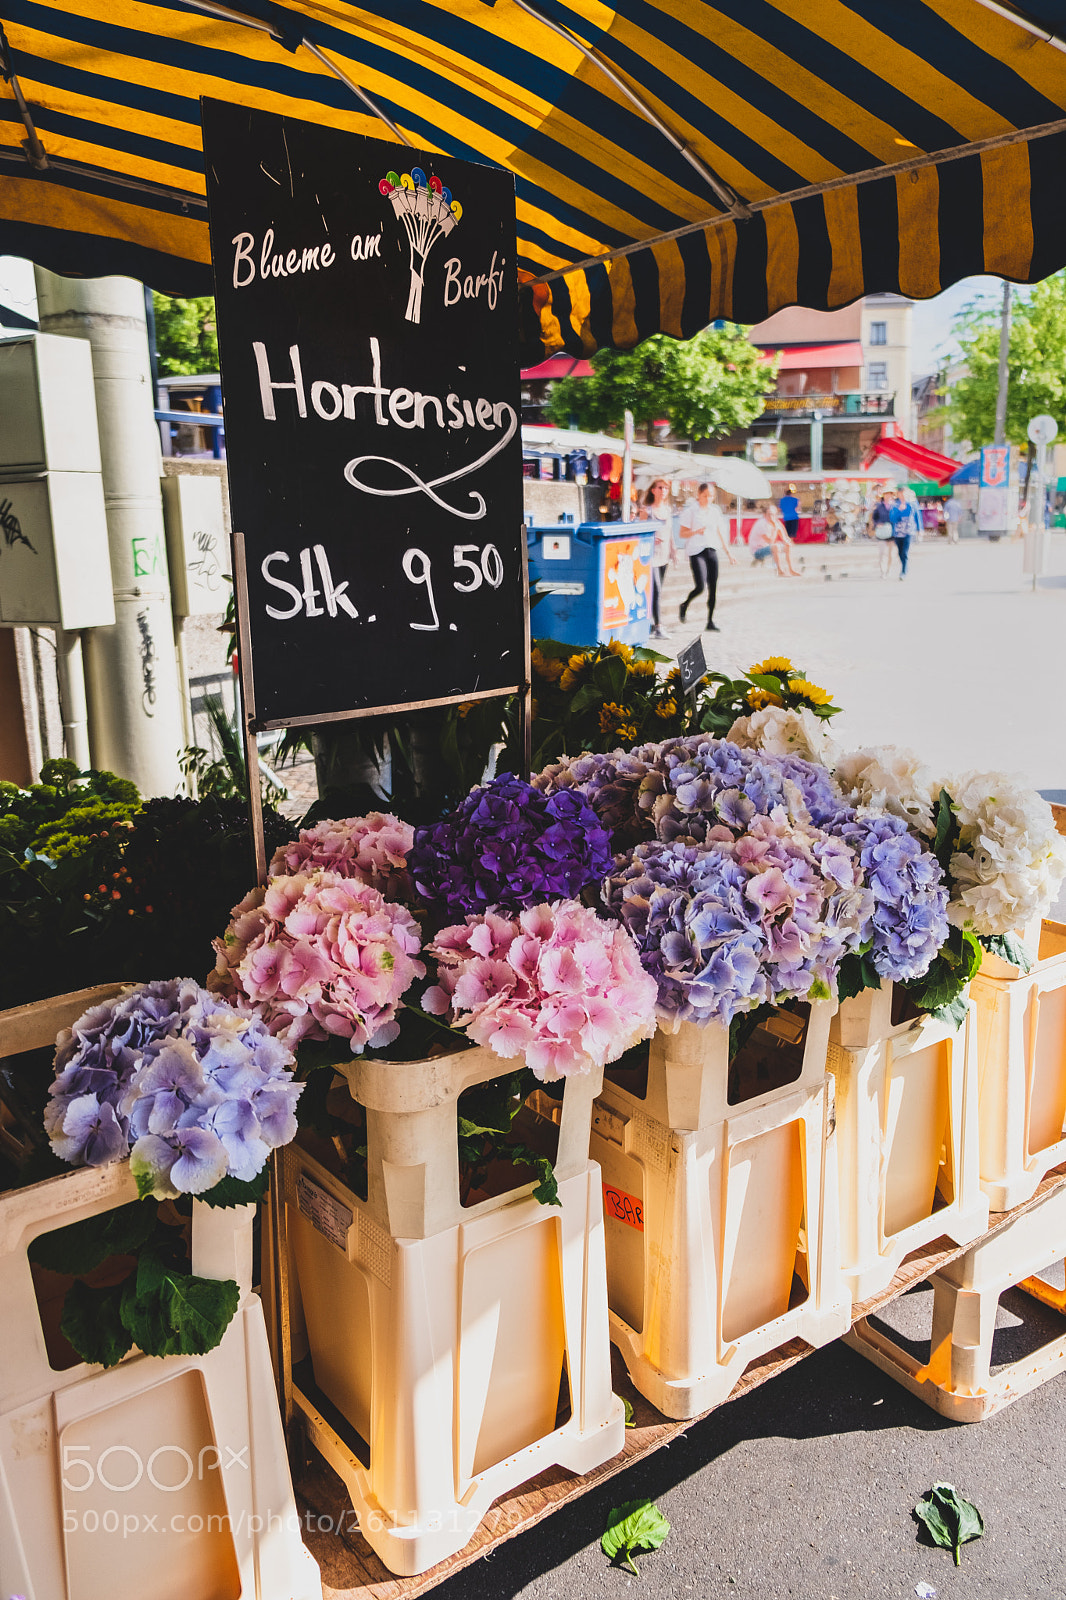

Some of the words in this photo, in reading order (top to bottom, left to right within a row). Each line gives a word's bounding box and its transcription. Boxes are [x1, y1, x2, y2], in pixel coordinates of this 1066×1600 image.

[231, 228, 336, 289] Blueme
[350, 233, 382, 261] am
[443, 250, 506, 311] Barfi
[252, 336, 518, 452] Hortensien
[260, 544, 377, 621] Stk.
